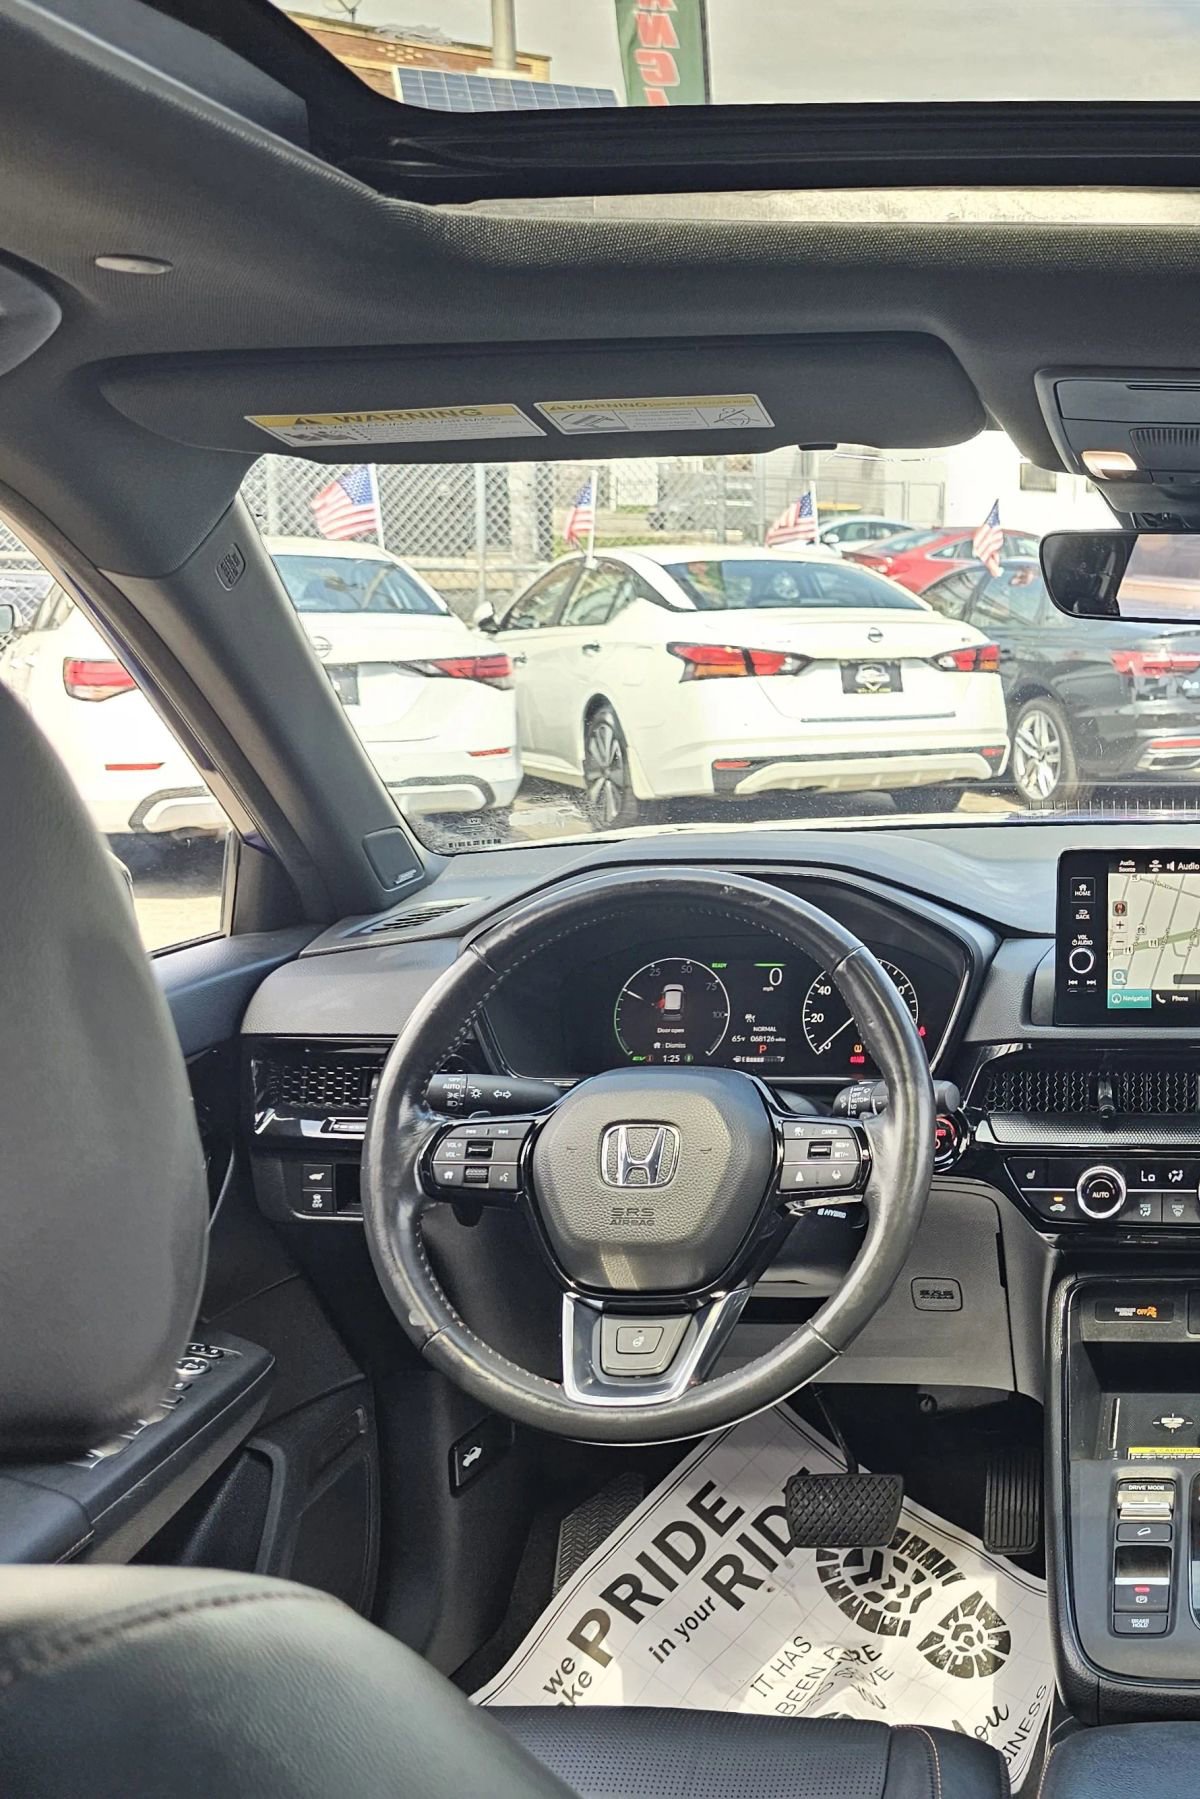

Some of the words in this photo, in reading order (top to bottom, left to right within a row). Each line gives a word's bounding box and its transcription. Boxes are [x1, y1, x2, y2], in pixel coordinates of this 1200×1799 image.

[566, 401, 648, 410] WARNING
[333, 408, 483, 424] WARNING
[1177, 861, 1200, 870] Audio
[650, 967, 661, 976] 25
[681, 965, 693, 974] 50
[769, 967, 783, 986] 0
[705, 983, 717, 991] 75
[818, 985, 832, 995] 40
[811, 1013, 824, 1023] 20
[759, 1044, 767, 1054] P
[663, 1054, 681, 1063] 1:25
[1140, 1170, 1156, 1182] Lo
[610, 1207, 655, 1217] SRS
[609, 1219, 655, 1227] AIRBAG
[566, 1479, 746, 1670] PRIDE
[648, 1639, 673, 1664] in
[673, 1595, 718, 1643] your
[701, 1478, 806, 1612] RID
[750, 1673, 774, 1698] IT
[770, 1636, 812, 1678] HAS
[543, 1655, 576, 1696] we
[775, 1666, 827, 1715] BEEN
